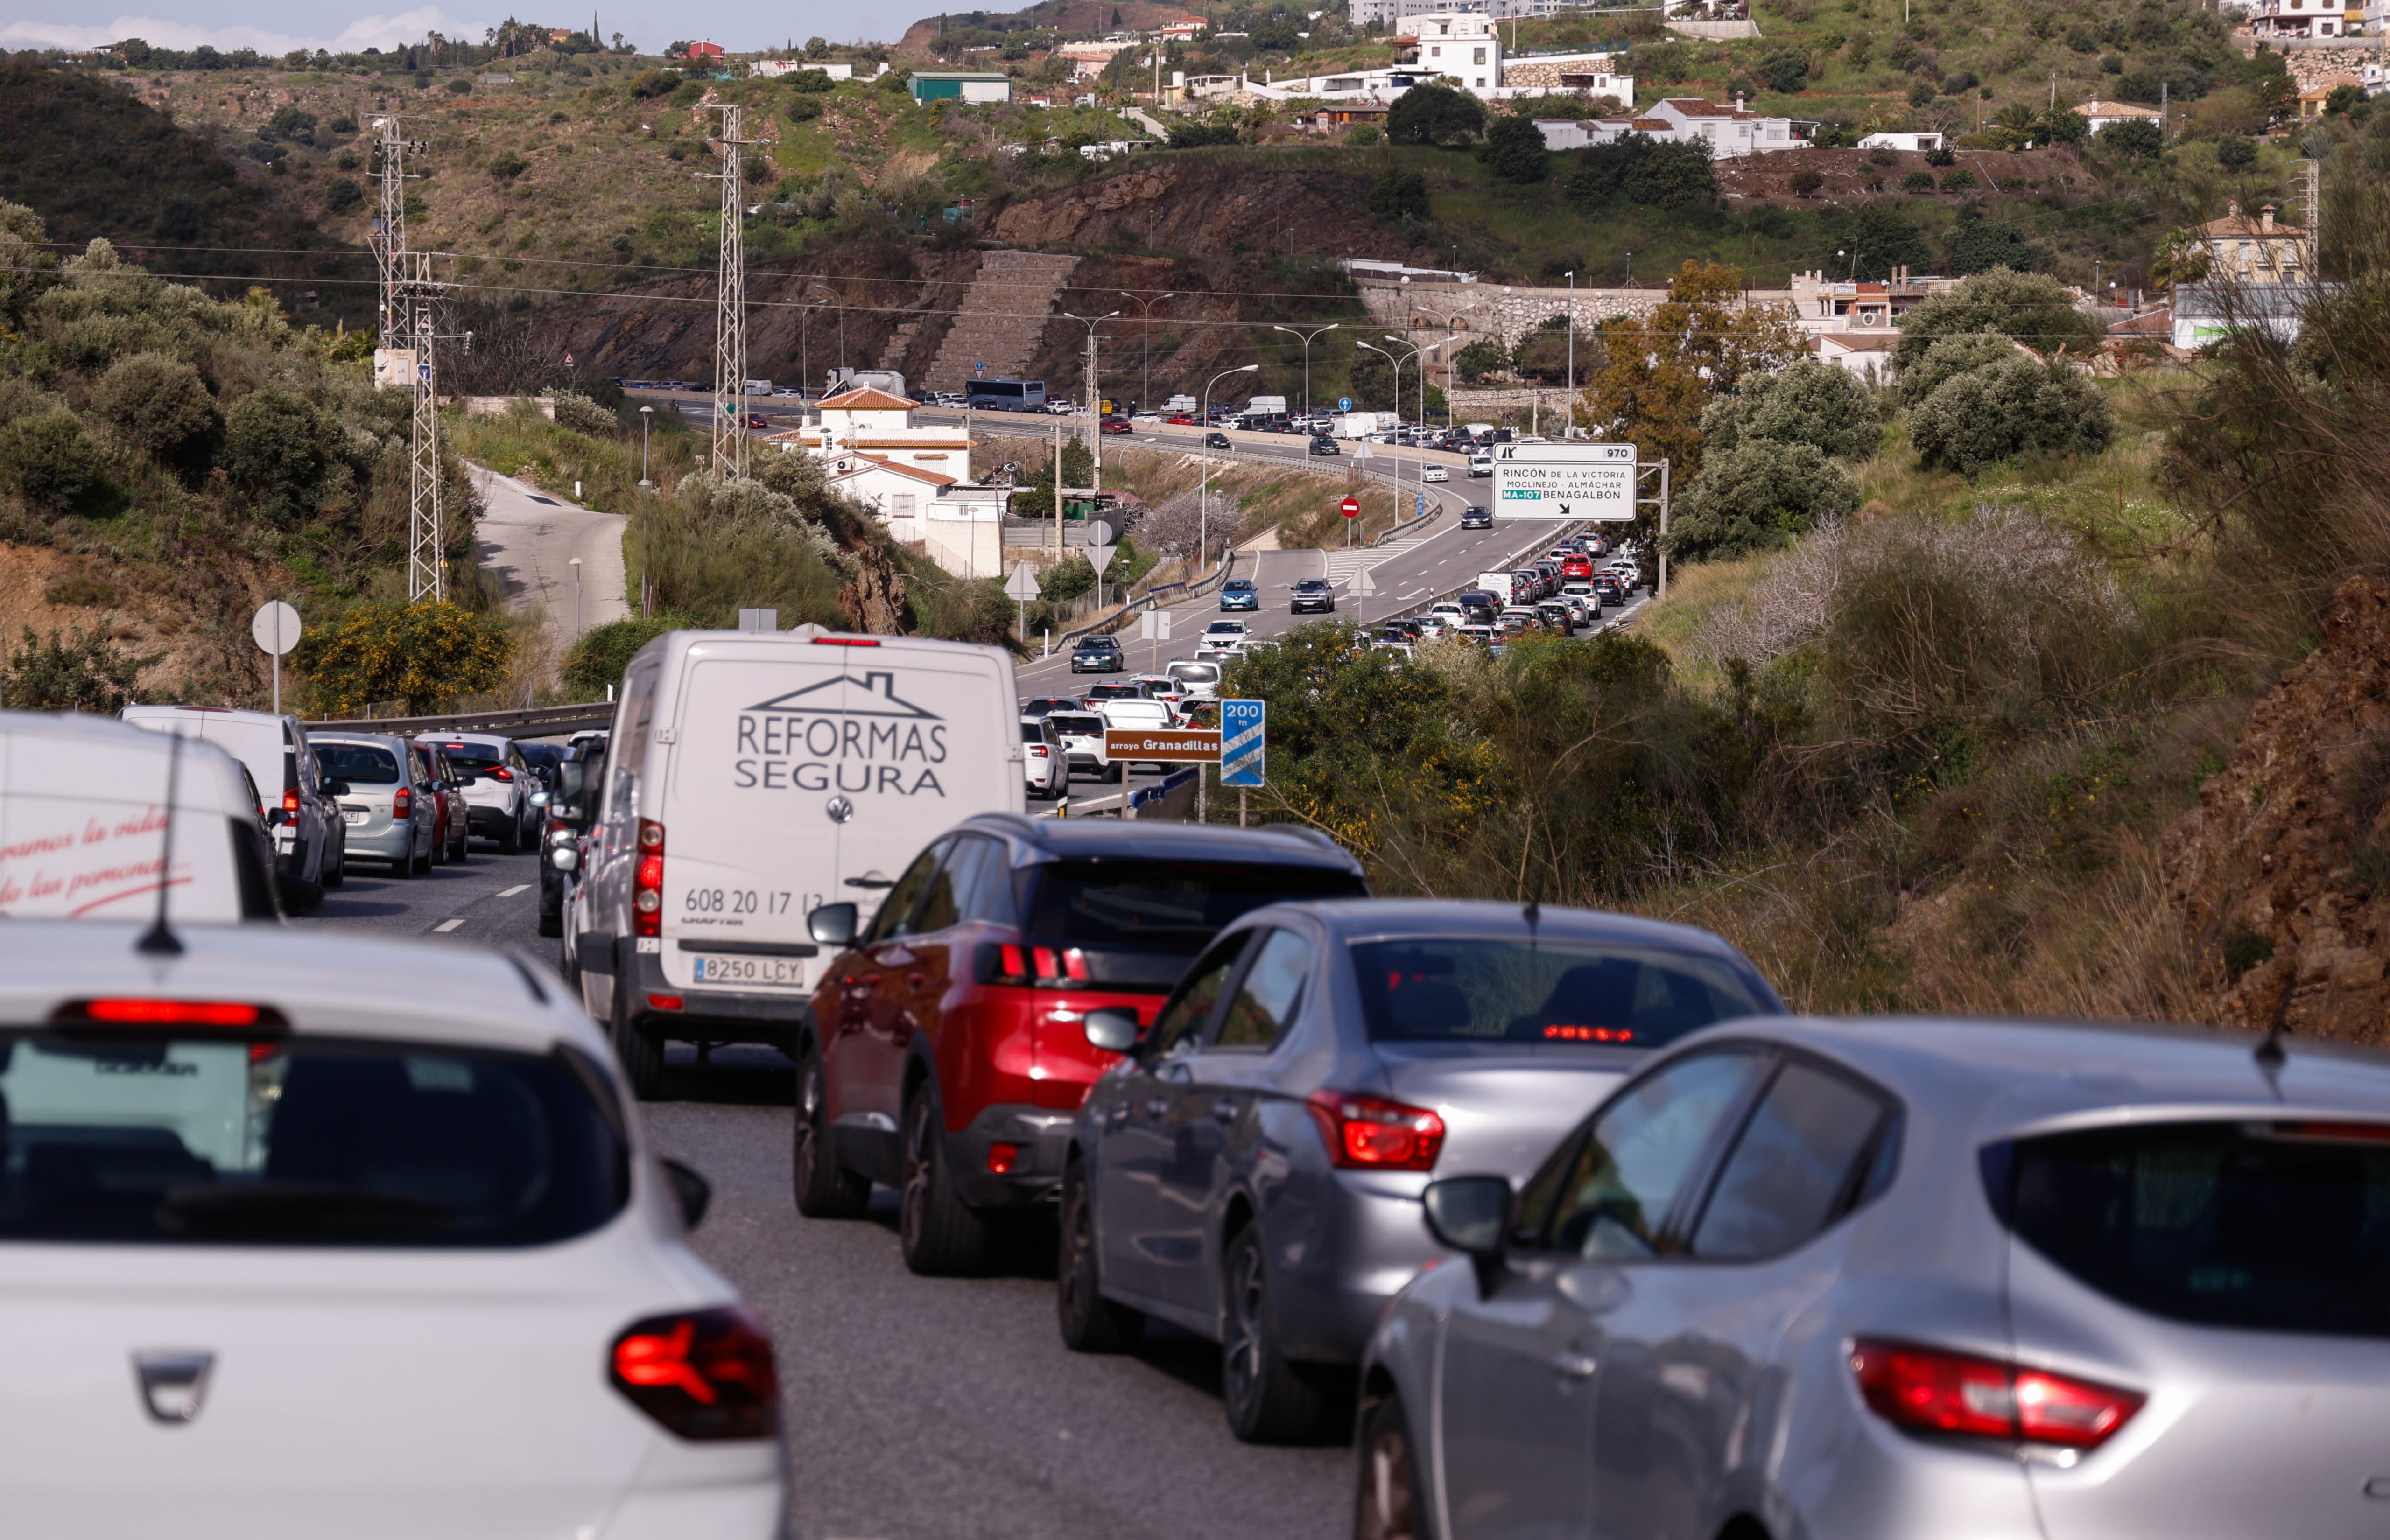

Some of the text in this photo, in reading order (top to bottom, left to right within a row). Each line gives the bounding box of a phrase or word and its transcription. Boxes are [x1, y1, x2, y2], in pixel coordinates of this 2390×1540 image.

[1607, 448, 1628, 458] 970
[1503, 468, 1546, 478] RINCÓN
[1568, 480, 1621, 489] ALMÁCHAR
[1503, 489, 1620, 499] MA-107 BENAGALBÓN
[1227, 705, 1259, 717] 200
[738, 715, 947, 764] REFORMAS
[1143, 739, 1218, 751] Granadillas
[734, 759, 946, 797] SEGURA
[686, 888, 724, 912] 608
[732, 890, 758, 914] 20
[769, 892, 792, 915] 17
[707, 960, 798, 980] 8250 LCY
